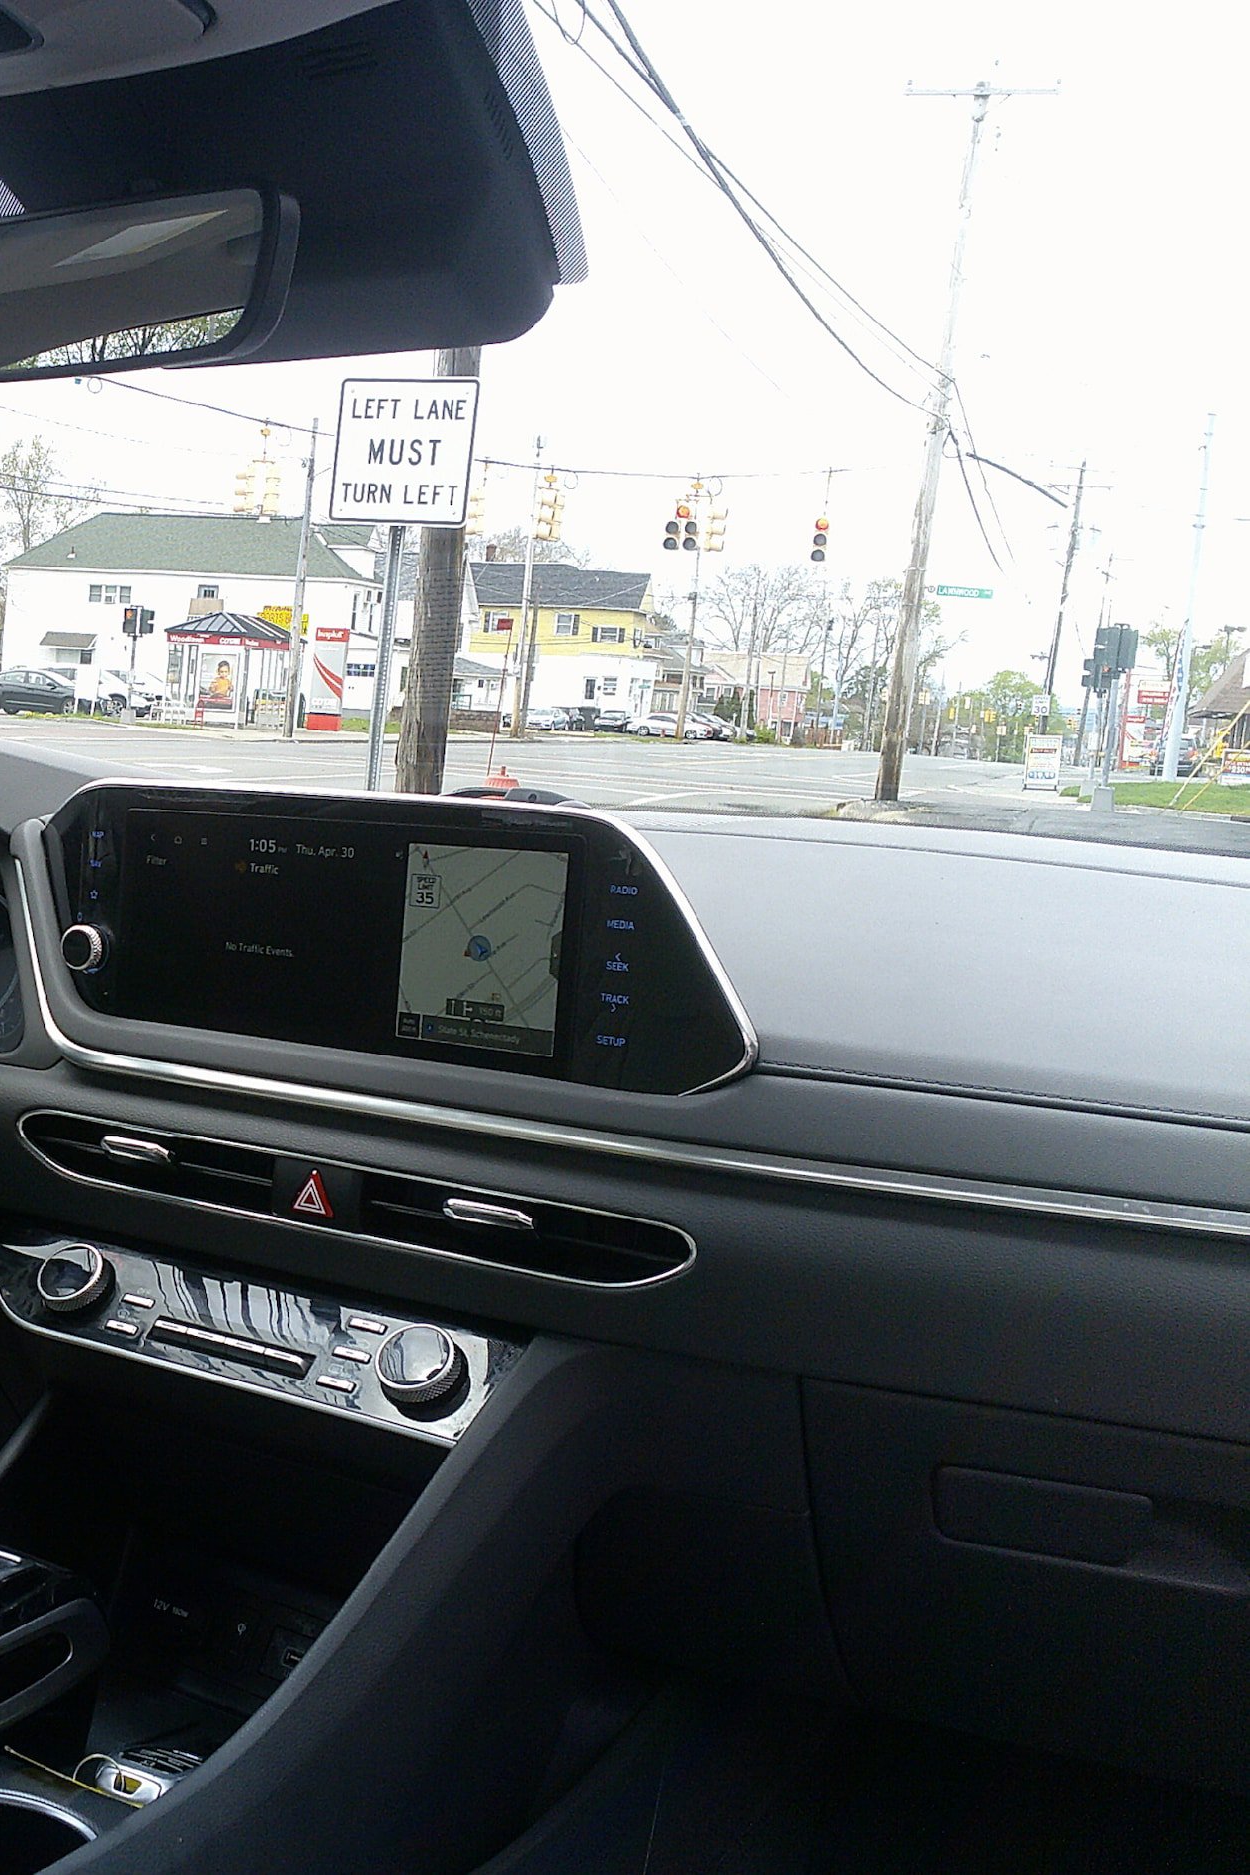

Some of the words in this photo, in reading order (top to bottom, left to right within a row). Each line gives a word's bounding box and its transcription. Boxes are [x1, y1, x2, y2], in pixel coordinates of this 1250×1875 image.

[352, 398, 401, 419] LEFT
[414, 399, 467, 420] LANE
[368, 438, 442, 466] MUST
[342, 483, 392, 504] TURN
[403, 485, 458, 506] LEFT
[1034, 706, 1048, 714] 30
[250, 838, 277, 853] 1:05
[341, 847, 355, 859] 30
[146, 854, 167, 866] Filter
[250, 863, 279, 875] Traffic
[610, 884, 638, 895] RADIO
[415, 892, 434, 904] 35
[606, 920, 635, 931] MEDIA
[225, 942, 237, 952] No
[239, 943, 265, 955] Traffic
[606, 961, 629, 972] SEEK
[601, 993, 629, 1005] TRACK
[596, 1035, 626, 1047] SETUP
[153, 1598, 171, 1610] 12V
